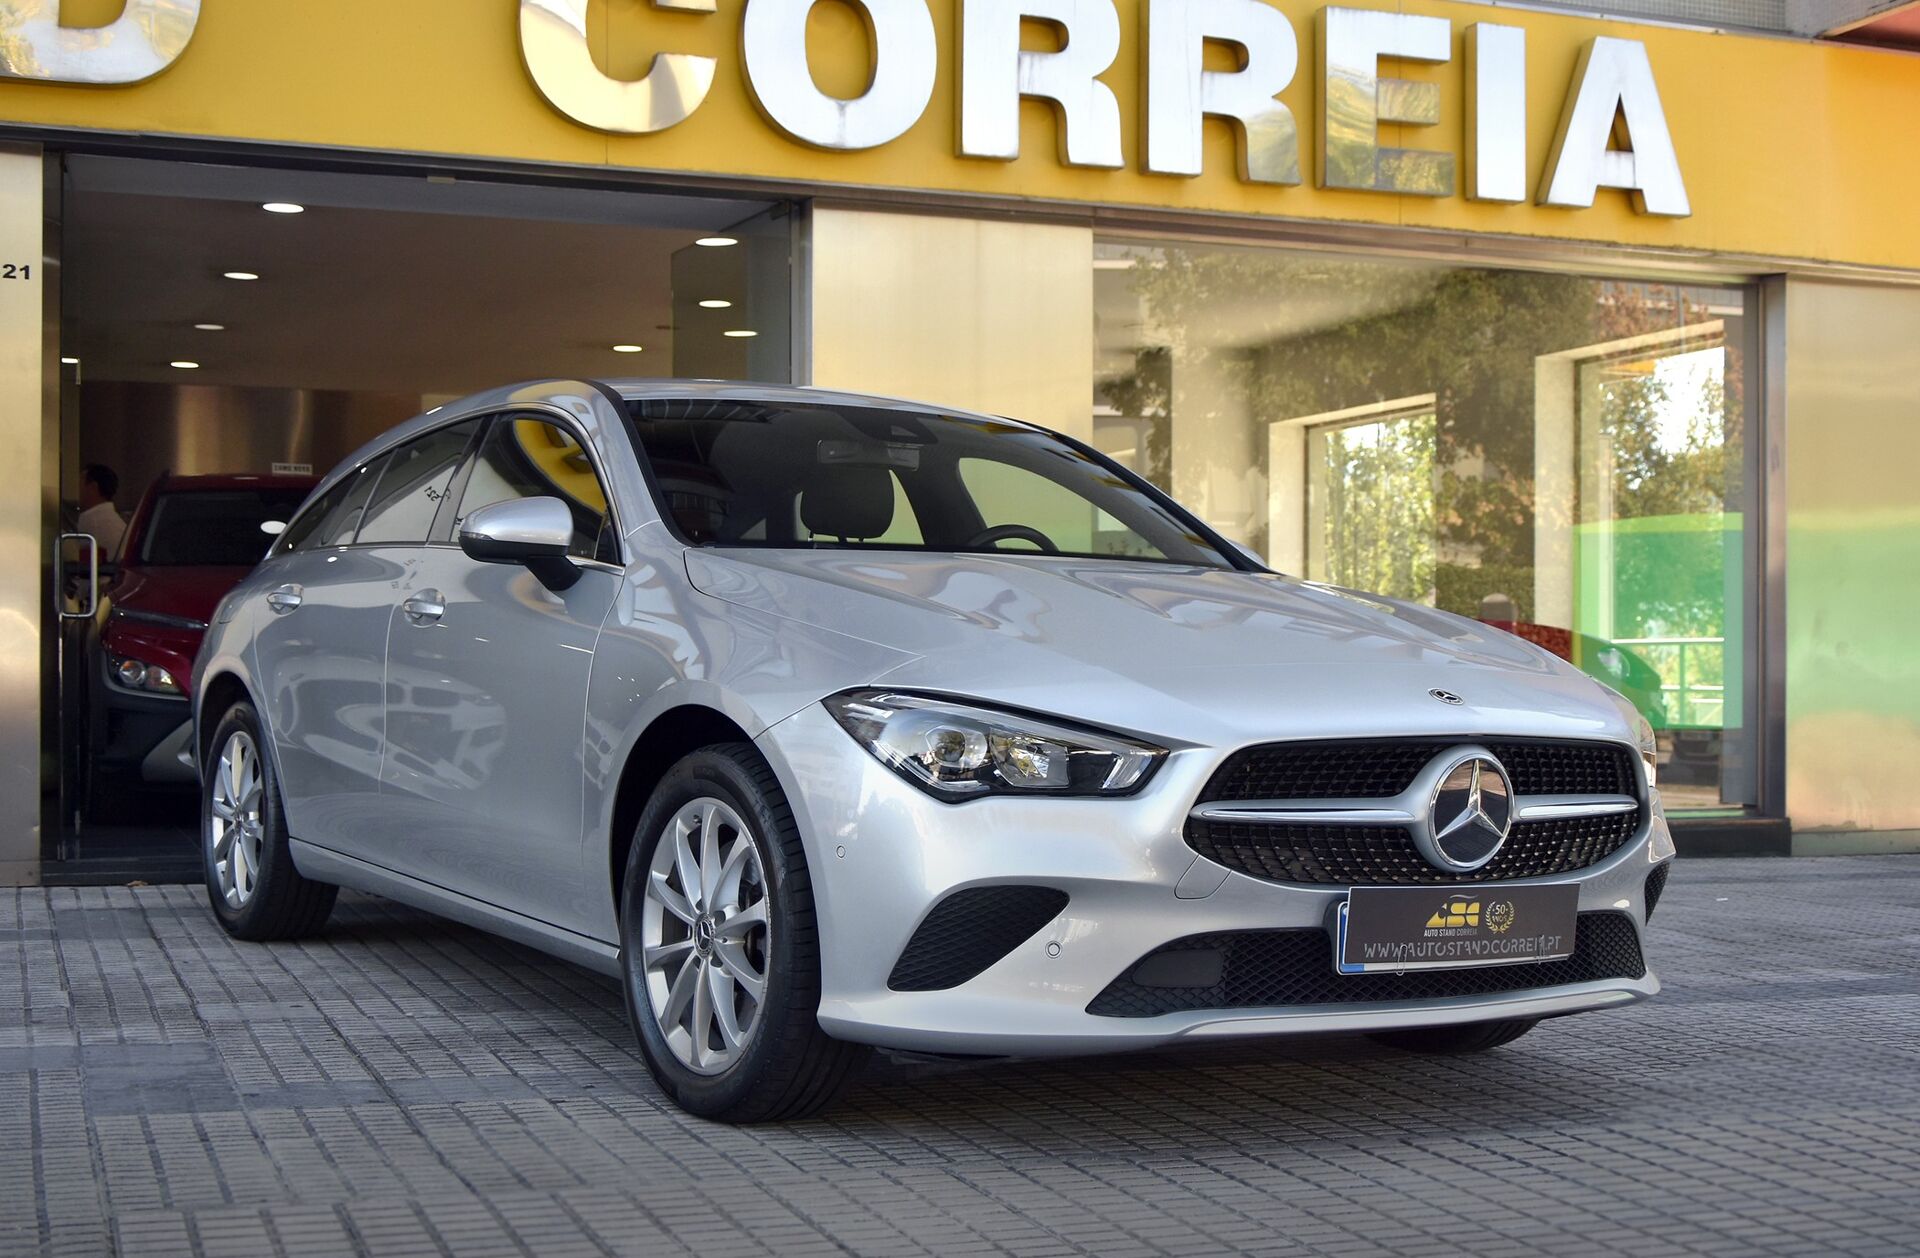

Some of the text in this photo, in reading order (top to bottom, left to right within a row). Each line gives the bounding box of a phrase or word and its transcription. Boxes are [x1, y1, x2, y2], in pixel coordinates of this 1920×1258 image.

[519, 0, 1692, 218] CORREIA
[2, 264, 30, 280] 21
[1495, 904, 1506, 915] 50
[1423, 928, 1478, 937] AUTO STAND CORREIA
